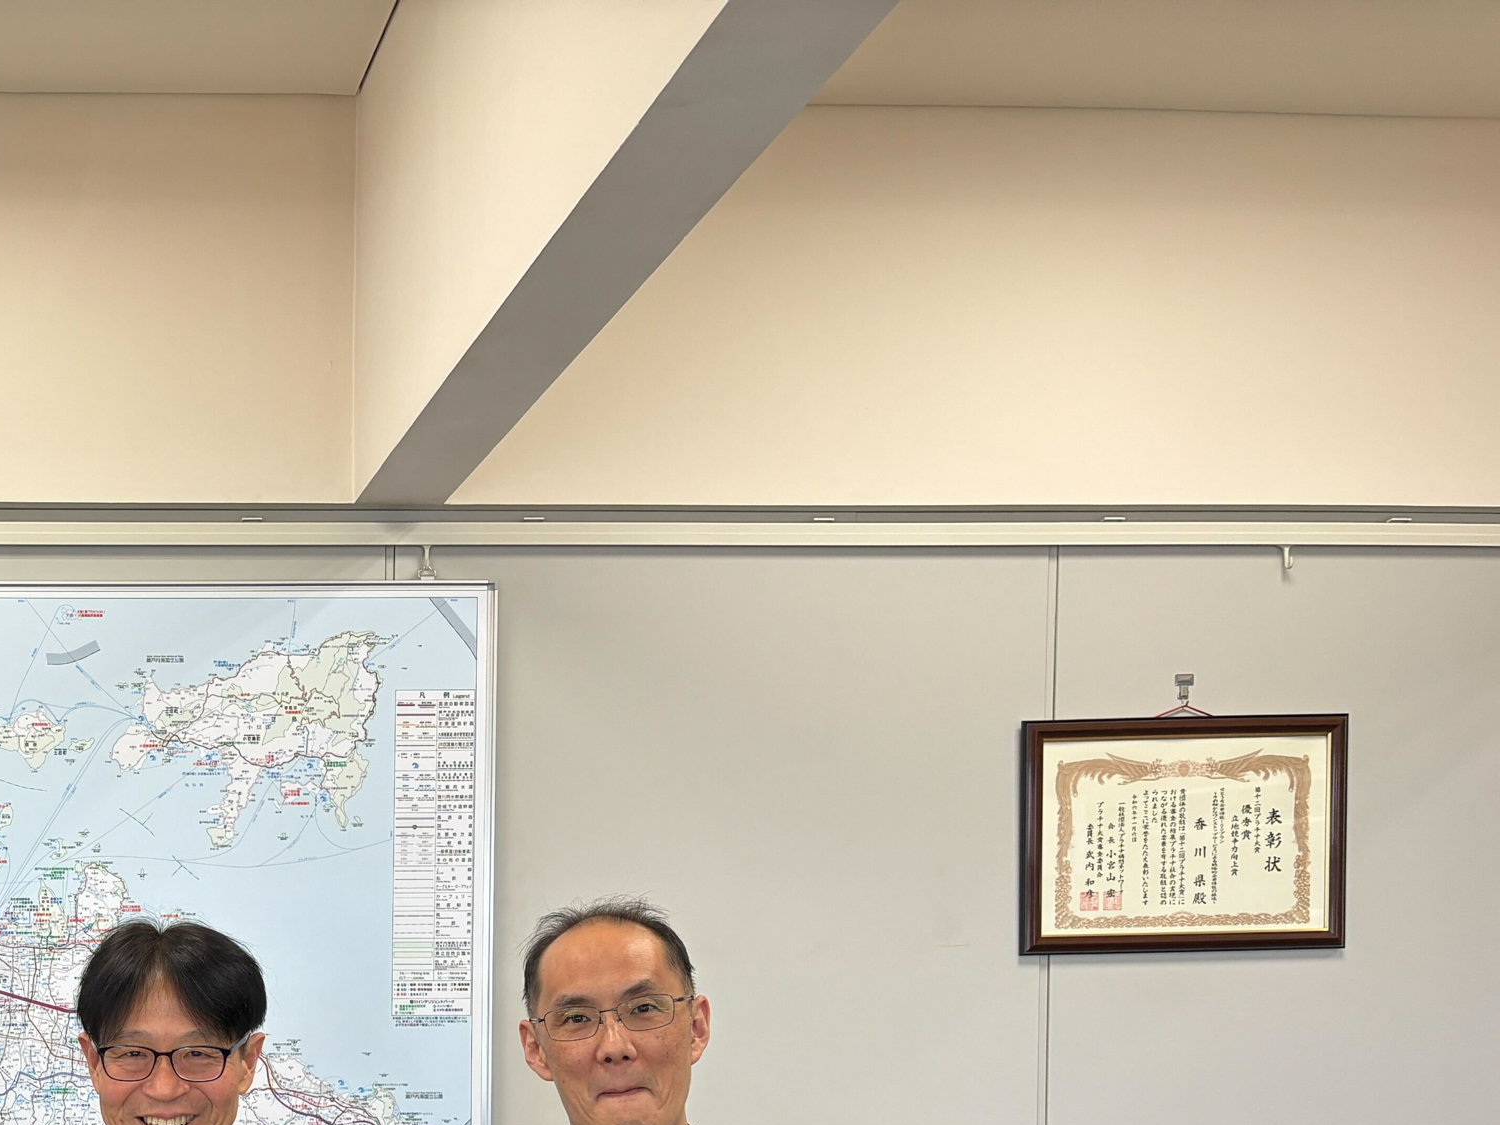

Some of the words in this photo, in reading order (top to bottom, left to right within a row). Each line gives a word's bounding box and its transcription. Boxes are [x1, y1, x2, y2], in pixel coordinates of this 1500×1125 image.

[1230, 815, 1239, 876] 立地競争力向上賞
[1240, 804, 1252, 841] 優秀賞
[1254, 786, 1262, 854] 第十二回プラチナ大賞
[1264, 808, 1282, 873] 表彰状
[1192, 817, 1208, 905] 香川県殿
